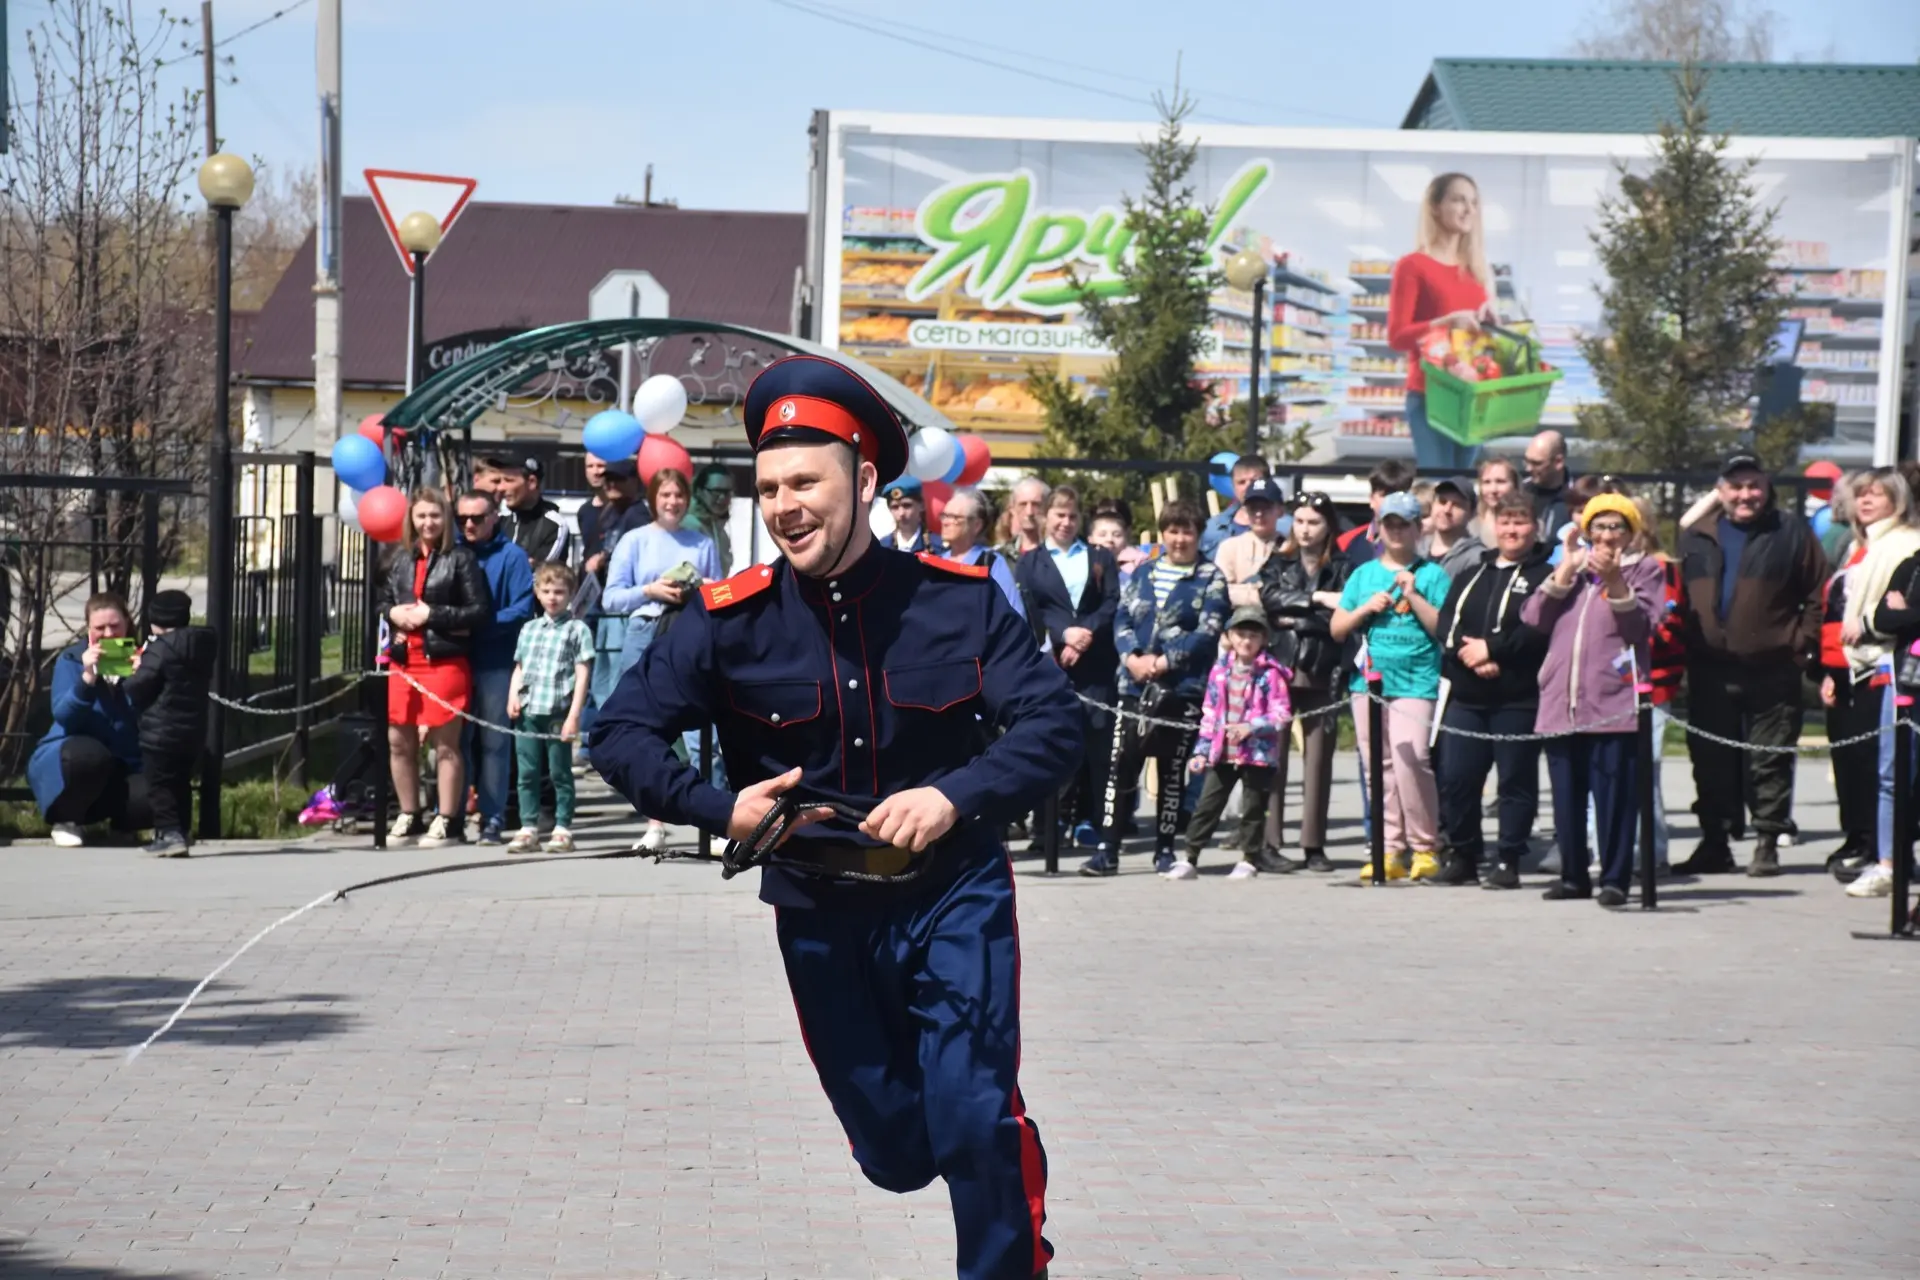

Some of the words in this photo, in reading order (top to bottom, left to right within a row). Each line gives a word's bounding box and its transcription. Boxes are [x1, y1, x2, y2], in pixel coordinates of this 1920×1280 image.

[915, 163, 1268, 304] Ярч!
[913, 323, 971, 344] сеть
[978, 327, 1108, 349] магазино
